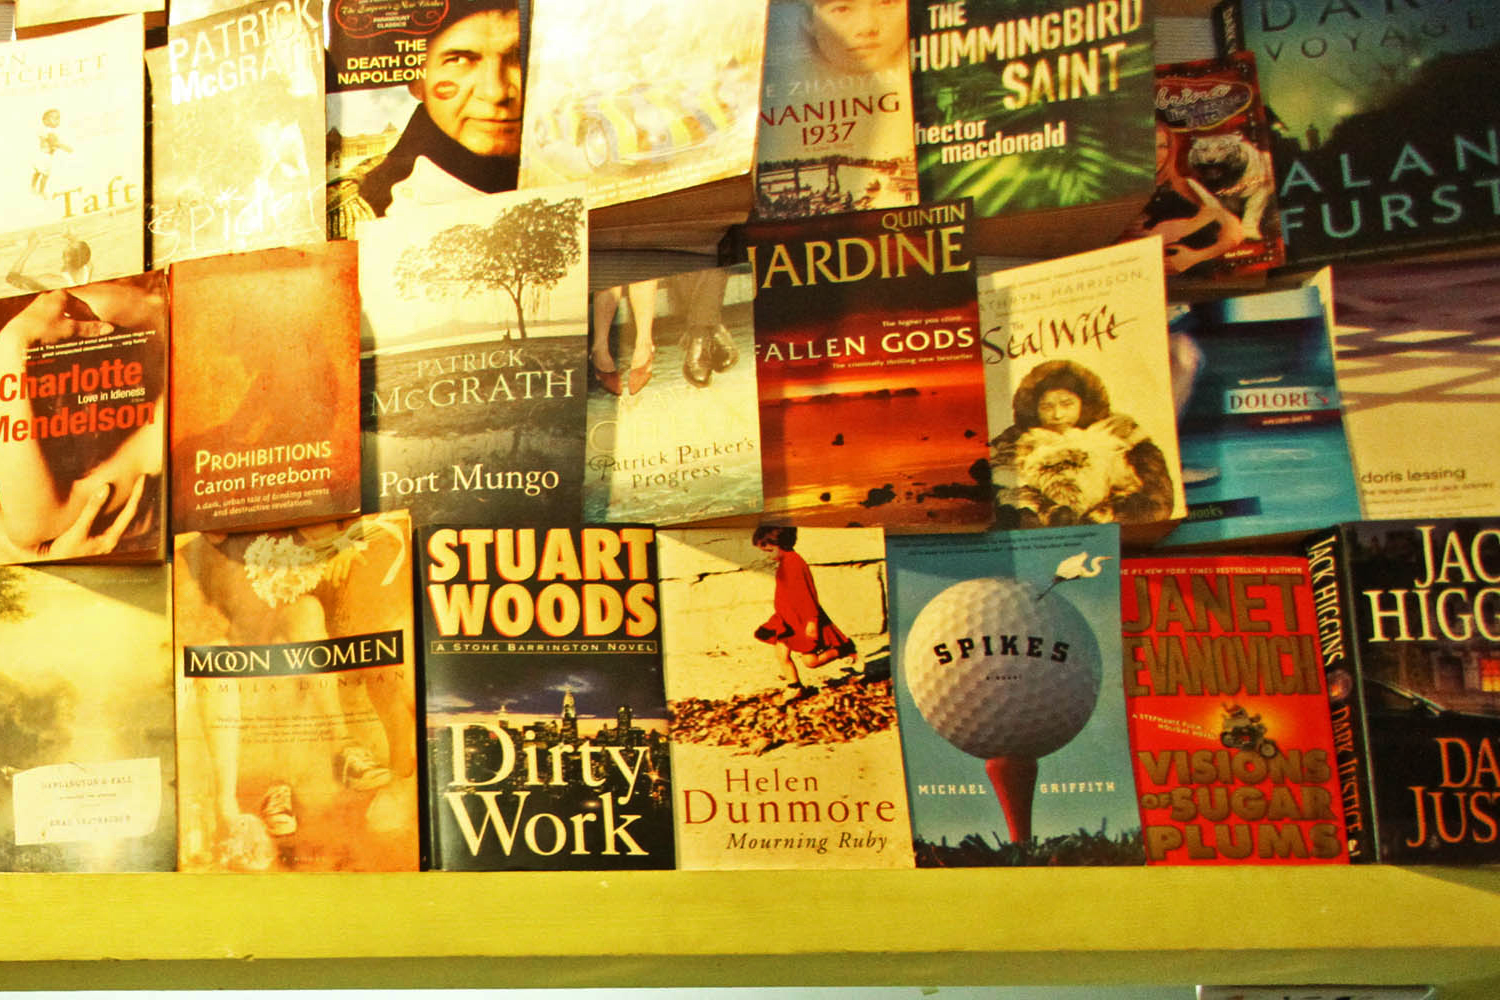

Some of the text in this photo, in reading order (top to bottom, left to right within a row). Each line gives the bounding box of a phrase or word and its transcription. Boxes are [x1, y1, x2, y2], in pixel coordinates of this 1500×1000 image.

[928, 2, 966, 30] THE
[168, 1, 320, 72] PATRICK
[395, 39, 427, 52] THE
[910, 0, 1142, 73] HUMMINGBIRD
[1264, 12, 1485, 62] VOYAGE
[170, 33, 323, 105] McGRATH
[338, 68, 427, 85] NAPOLEON
[347, 53, 427, 70] DEATH OF
[1002, 42, 1127, 111] SAINT
[760, 92, 900, 127] NANJING
[802, 121, 857, 146] 1937
[915, 120, 987, 145] hector
[941, 121, 1067, 165] macdonald
[1280, 126, 1500, 197] ALAN
[53, 176, 136, 219] Taft
[1280, 177, 1500, 245] FURST
[882, 203, 966, 232] QUINTIN
[747, 225, 971, 299] JARDINE
[755, 327, 975, 363] FALLEN GODS
[981, 303, 1139, 365] Seal Wife
[0, 357, 143, 401] Charlotte
[417, 347, 525, 379] PATRICK
[78, 387, 146, 405] Love in Idleness
[371, 368, 575, 417] McGRATH
[1229, 391, 1329, 410] DOLORES
[195, 440, 332, 474] PROHIBITIONS
[588, 437, 755, 481] Patrick Parker's
[1361, 467, 1467, 484] doris lessing
[194, 465, 332, 496] Caron Freeborn
[379, 463, 560, 497] Port Mungo
[427, 526, 655, 584] STUART
[1270, 566, 1303, 574] AUTHOR
[426, 582, 657, 638] WOODS
[1122, 573, 1306, 635] JANET
[1307, 535, 1344, 668] JACK HIGGINS
[189, 636, 398, 674] MOON WOMEN
[436, 643, 446, 652] A
[933, 633, 1071, 667] SPIKES
[1123, 633, 1322, 698] EVANOVICH
[447, 721, 648, 805] Dirty
[725, 767, 819, 794] Helen
[1138, 749, 1332, 787] VISIONS
[1331, 704, 1363, 834] DARK JUSTICE
[683, 788, 896, 825] Dunmore
[917, 780, 1117, 796] MICHAEL GRIFFITH
[1141, 786, 1339, 823] OF SUGAR
[445, 790, 649, 858] Work
[726, 830, 888, 855] Mourning Ruby
[1145, 821, 1344, 862] PLUMS
